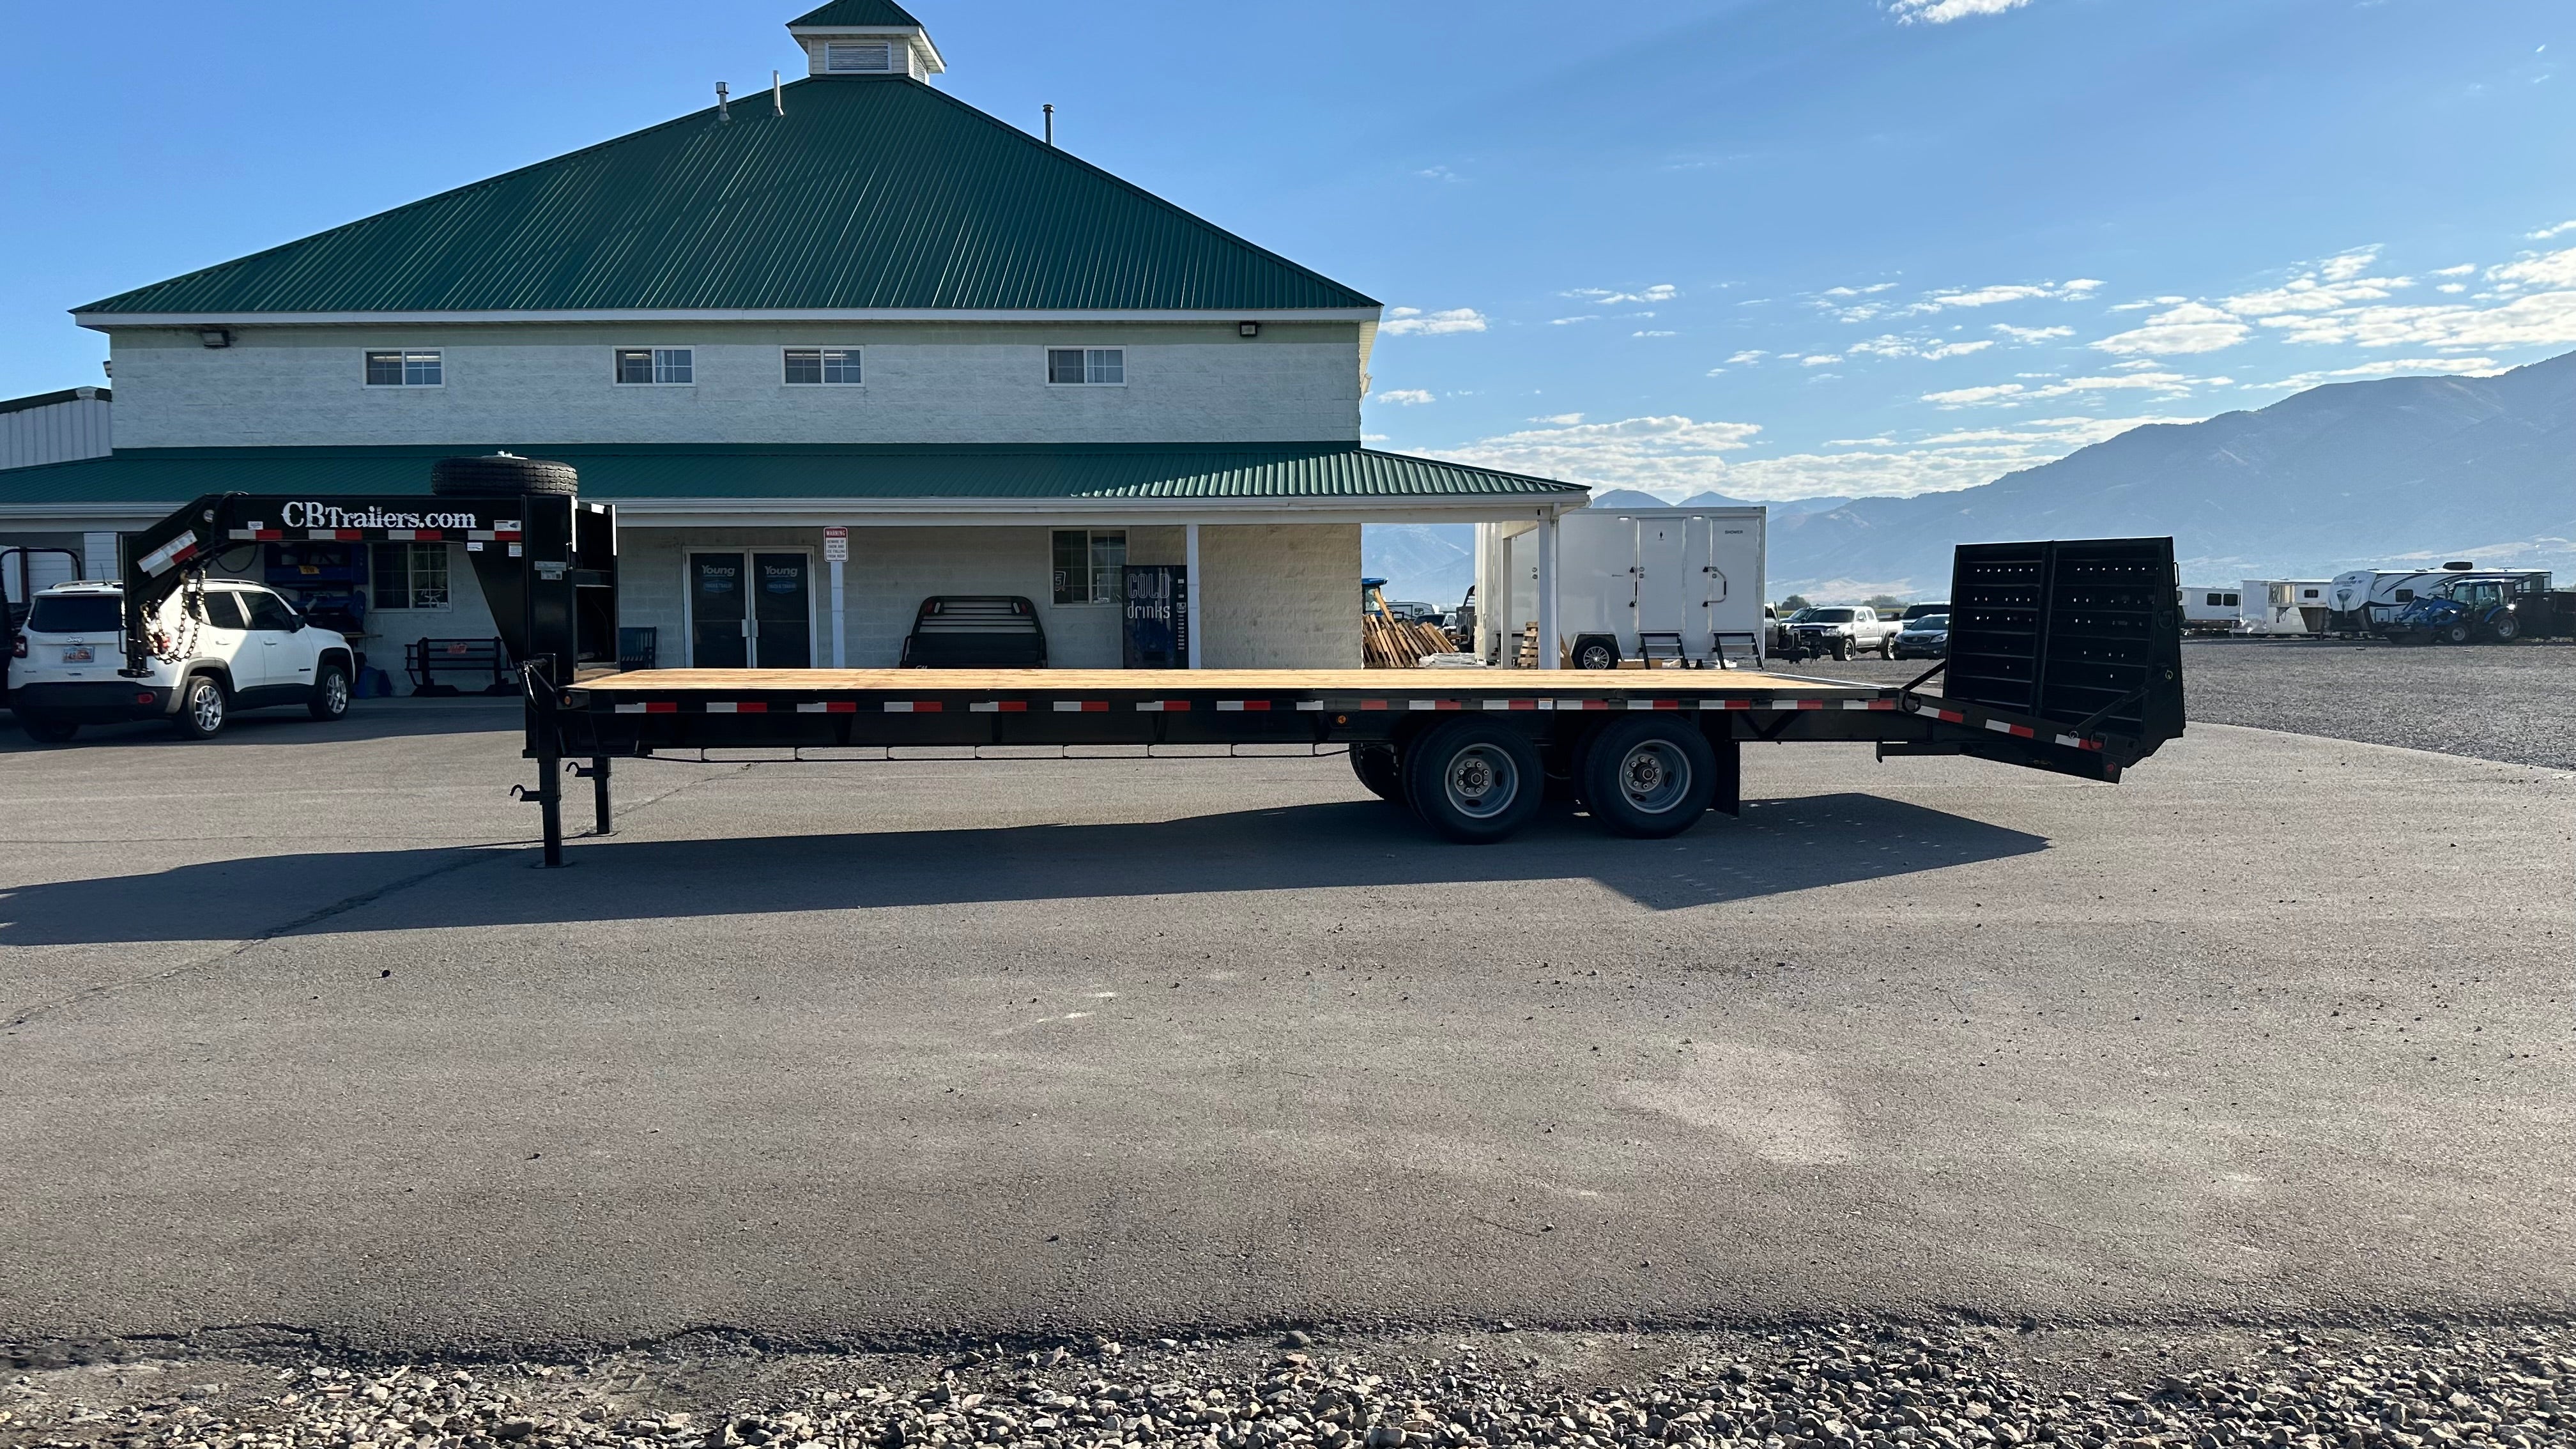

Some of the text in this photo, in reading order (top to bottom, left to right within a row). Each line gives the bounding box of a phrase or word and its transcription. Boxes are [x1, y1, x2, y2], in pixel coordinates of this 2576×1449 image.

[702, 565, 735, 577] Young
[764, 565, 798, 578] Young
[1128, 573, 1170, 599] COLD
[1127, 601, 1170, 619] drinks
